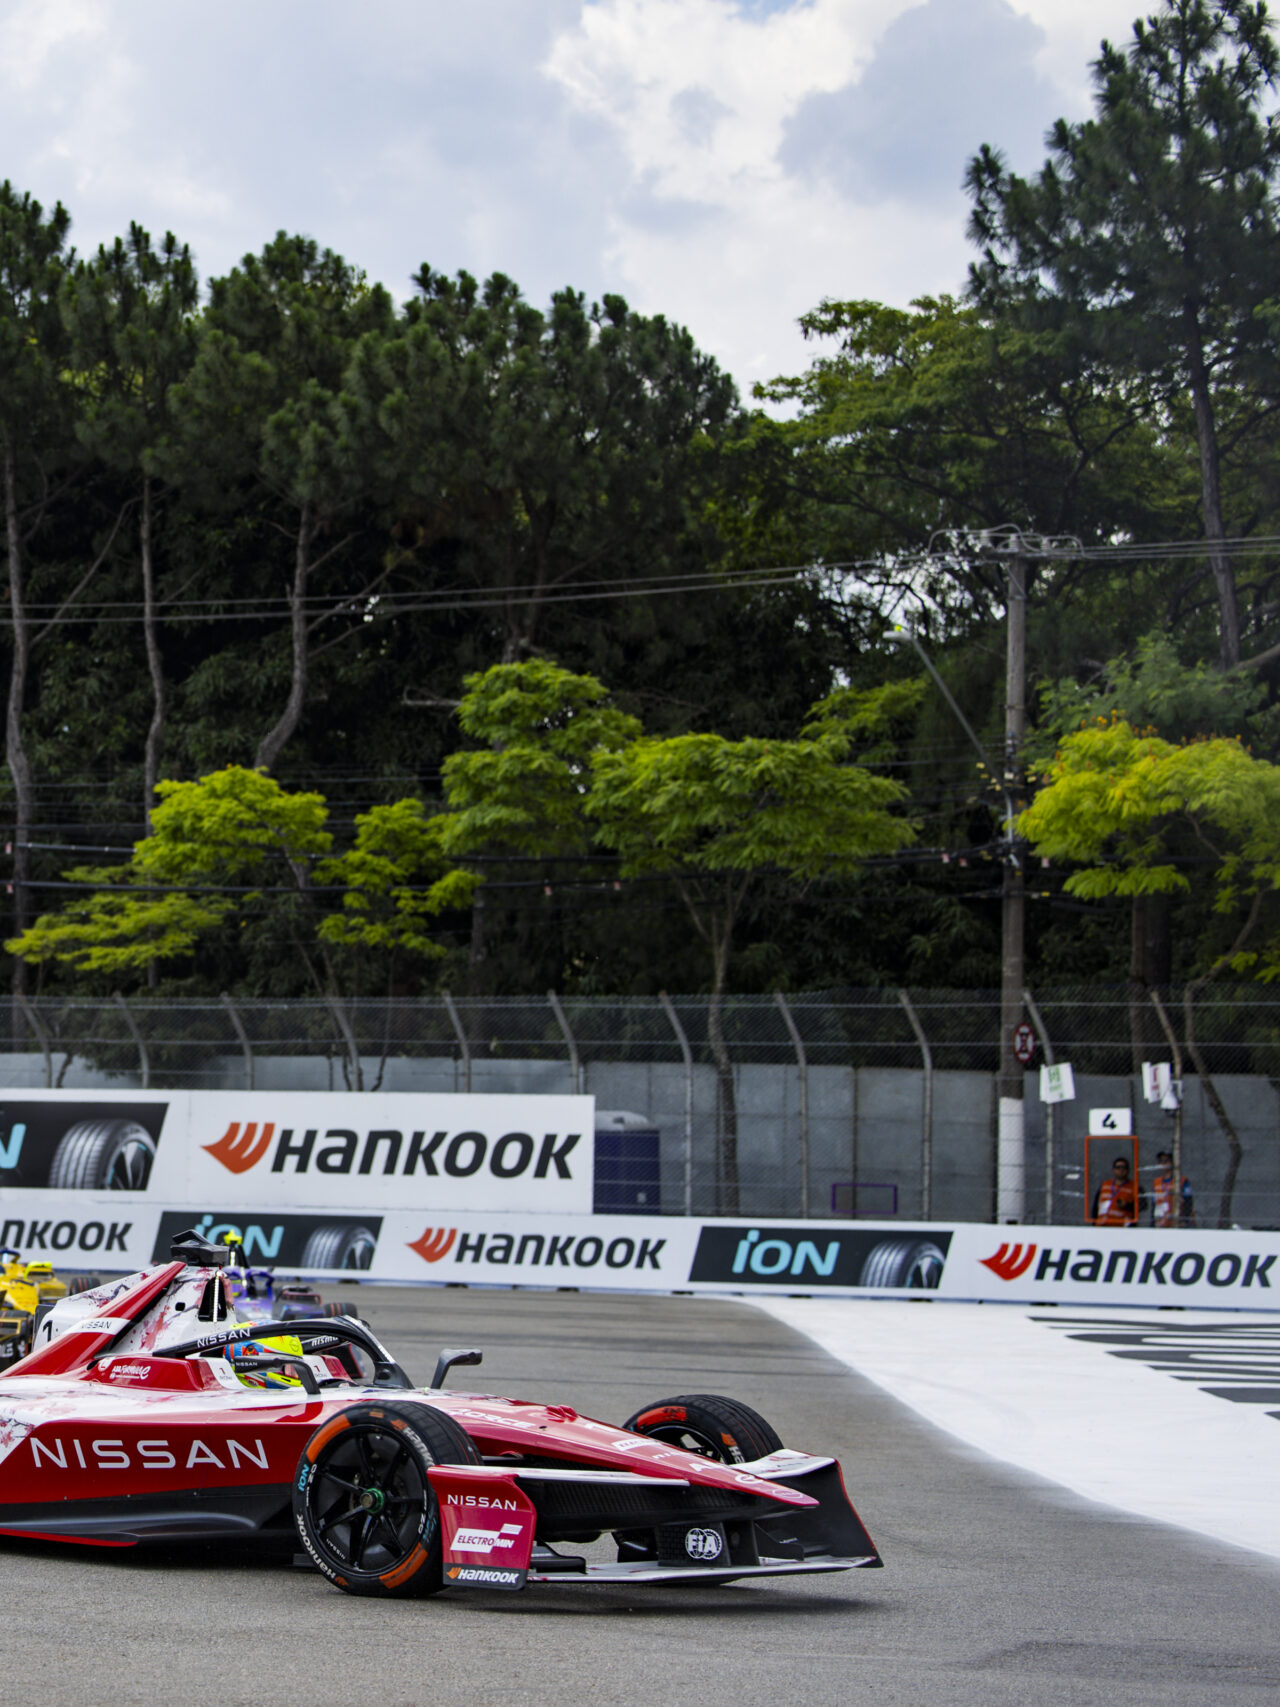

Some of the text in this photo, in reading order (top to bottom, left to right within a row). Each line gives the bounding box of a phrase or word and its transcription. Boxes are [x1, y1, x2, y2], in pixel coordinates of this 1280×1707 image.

[1102, 1114, 1117, 1129] 4
[197, 1327, 251, 1349] NISSAN
[30, 1437, 270, 1470] NISSAN
[447, 1494, 517, 1511] NISSAN
